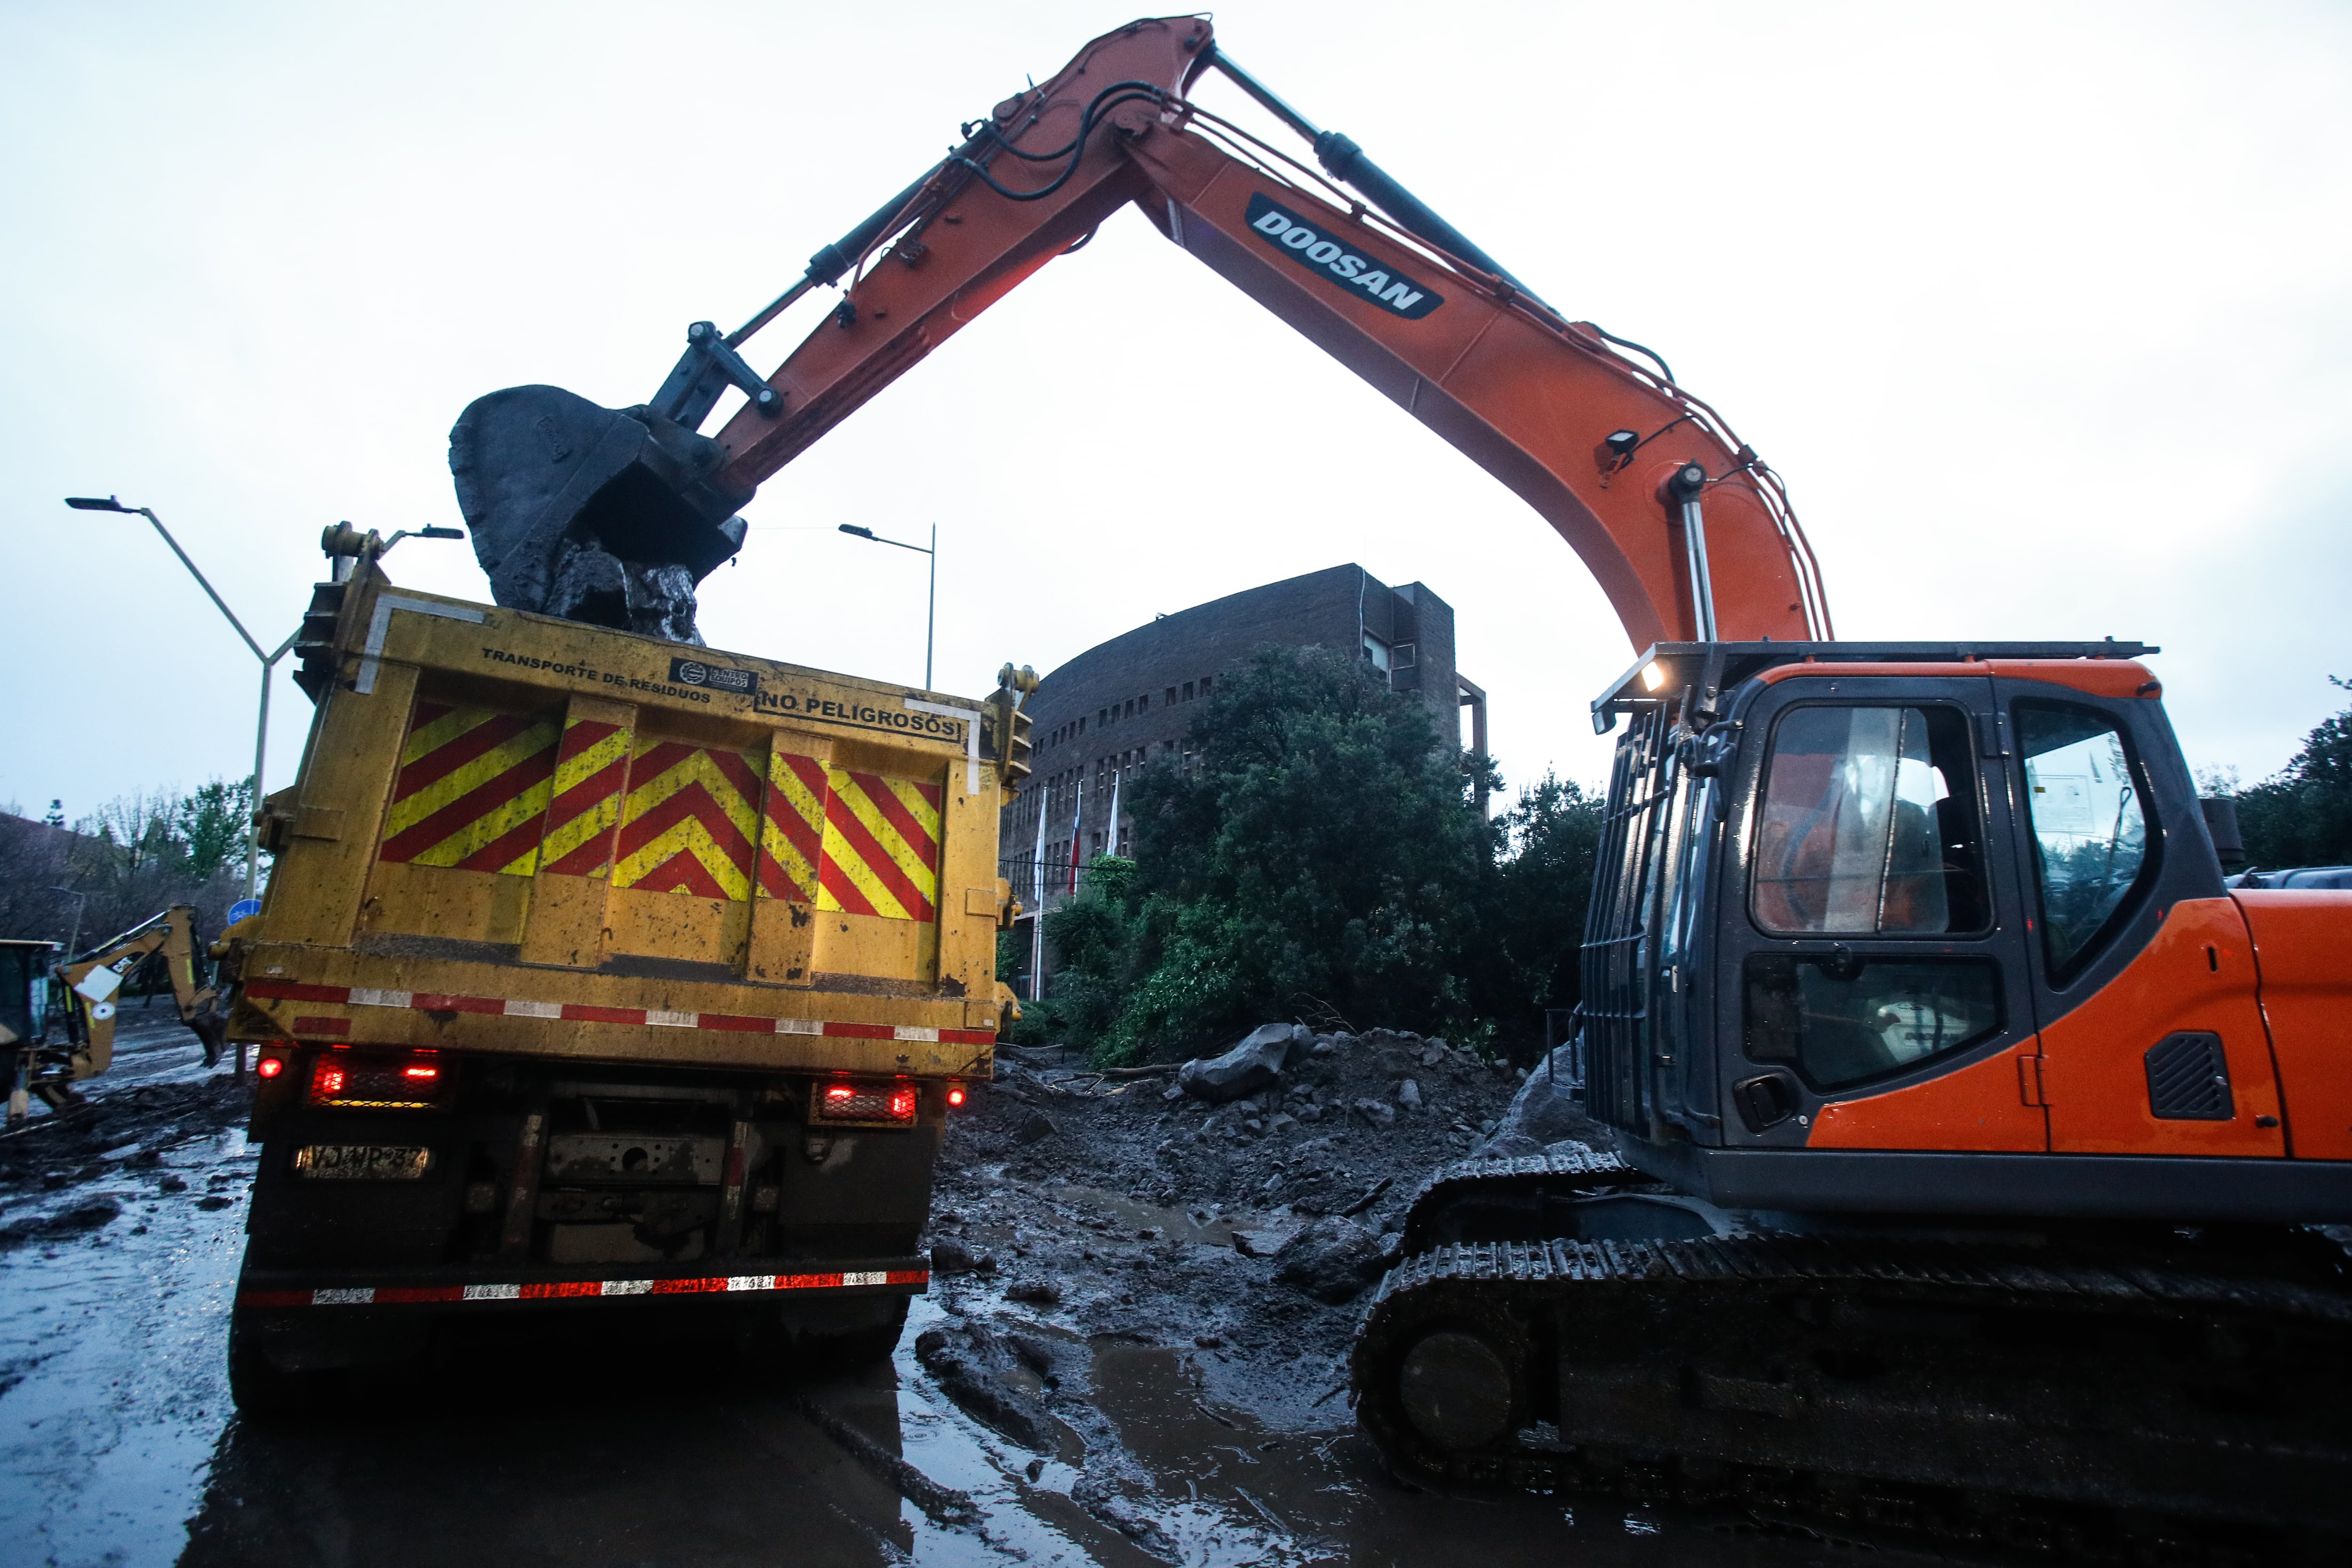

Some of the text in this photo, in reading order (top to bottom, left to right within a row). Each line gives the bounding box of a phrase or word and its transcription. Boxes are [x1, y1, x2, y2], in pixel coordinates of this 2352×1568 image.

[1253, 211, 1424, 310] DOOSAN
[482, 648, 598, 680] TRANSPORTE
[603, 673, 625, 686] DE
[629, 678, 711, 703] RESIDUOS
[711, 674, 747, 686] EQUIPOS
[761, 692, 954, 736] NO PELIGROSOS
